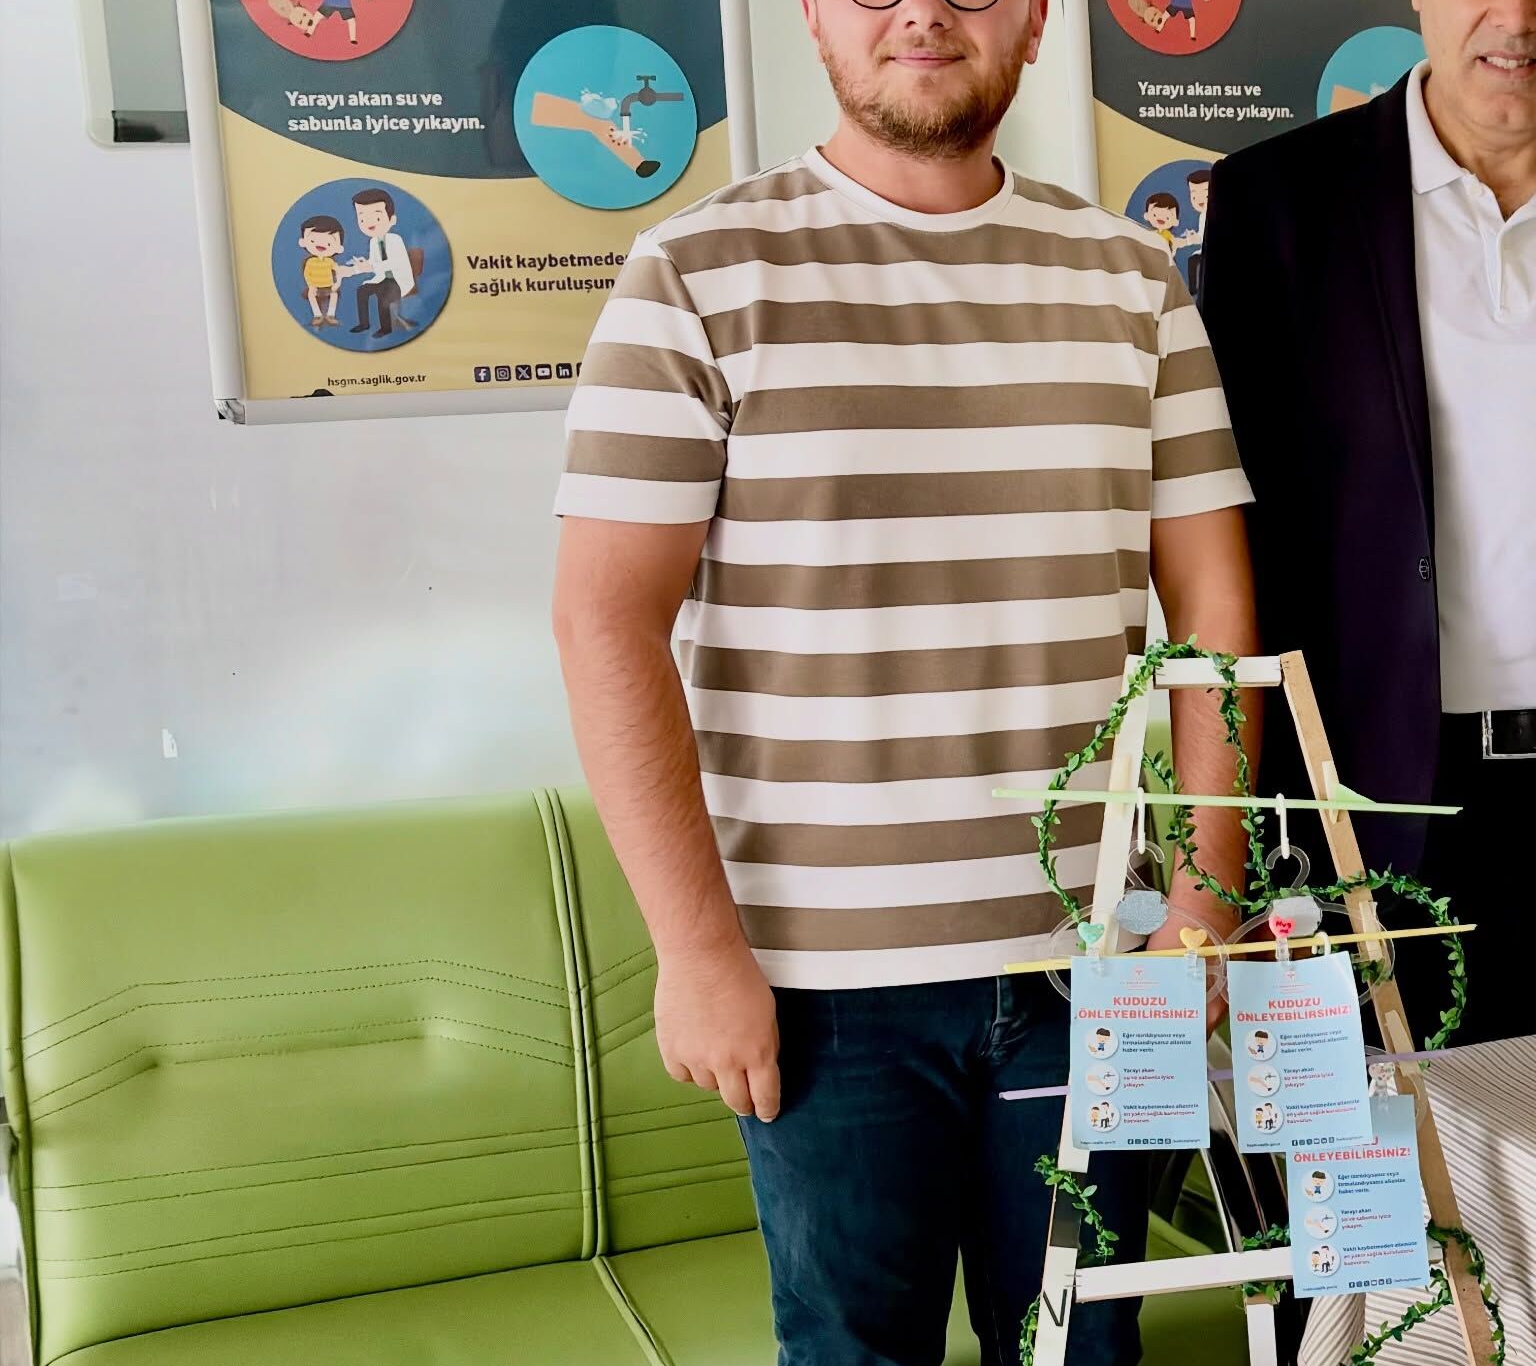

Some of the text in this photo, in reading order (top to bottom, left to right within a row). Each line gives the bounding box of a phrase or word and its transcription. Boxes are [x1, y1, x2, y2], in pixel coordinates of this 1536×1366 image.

[1137, 81, 1262, 99] Yarayı akan su ve
[285, 91, 442, 110] Yarayı akan su ve
[1139, 104, 1294, 121] sabunla iyice yıkayın.
[288, 114, 485, 135] sabunla iyice yıkayın.
[466, 252, 628, 272] Vakit kaybetmede
[469, 278, 522, 297] sağlık
[327, 372, 427, 389] hsgm.saglik.gov.tr
[1113, 996, 1167, 1007] KUDUZU
[1268, 997, 1320, 1009] KUDUZU
[1294, 1146, 1411, 1163] ÖNLEYEBİLİRSİNİZ!
